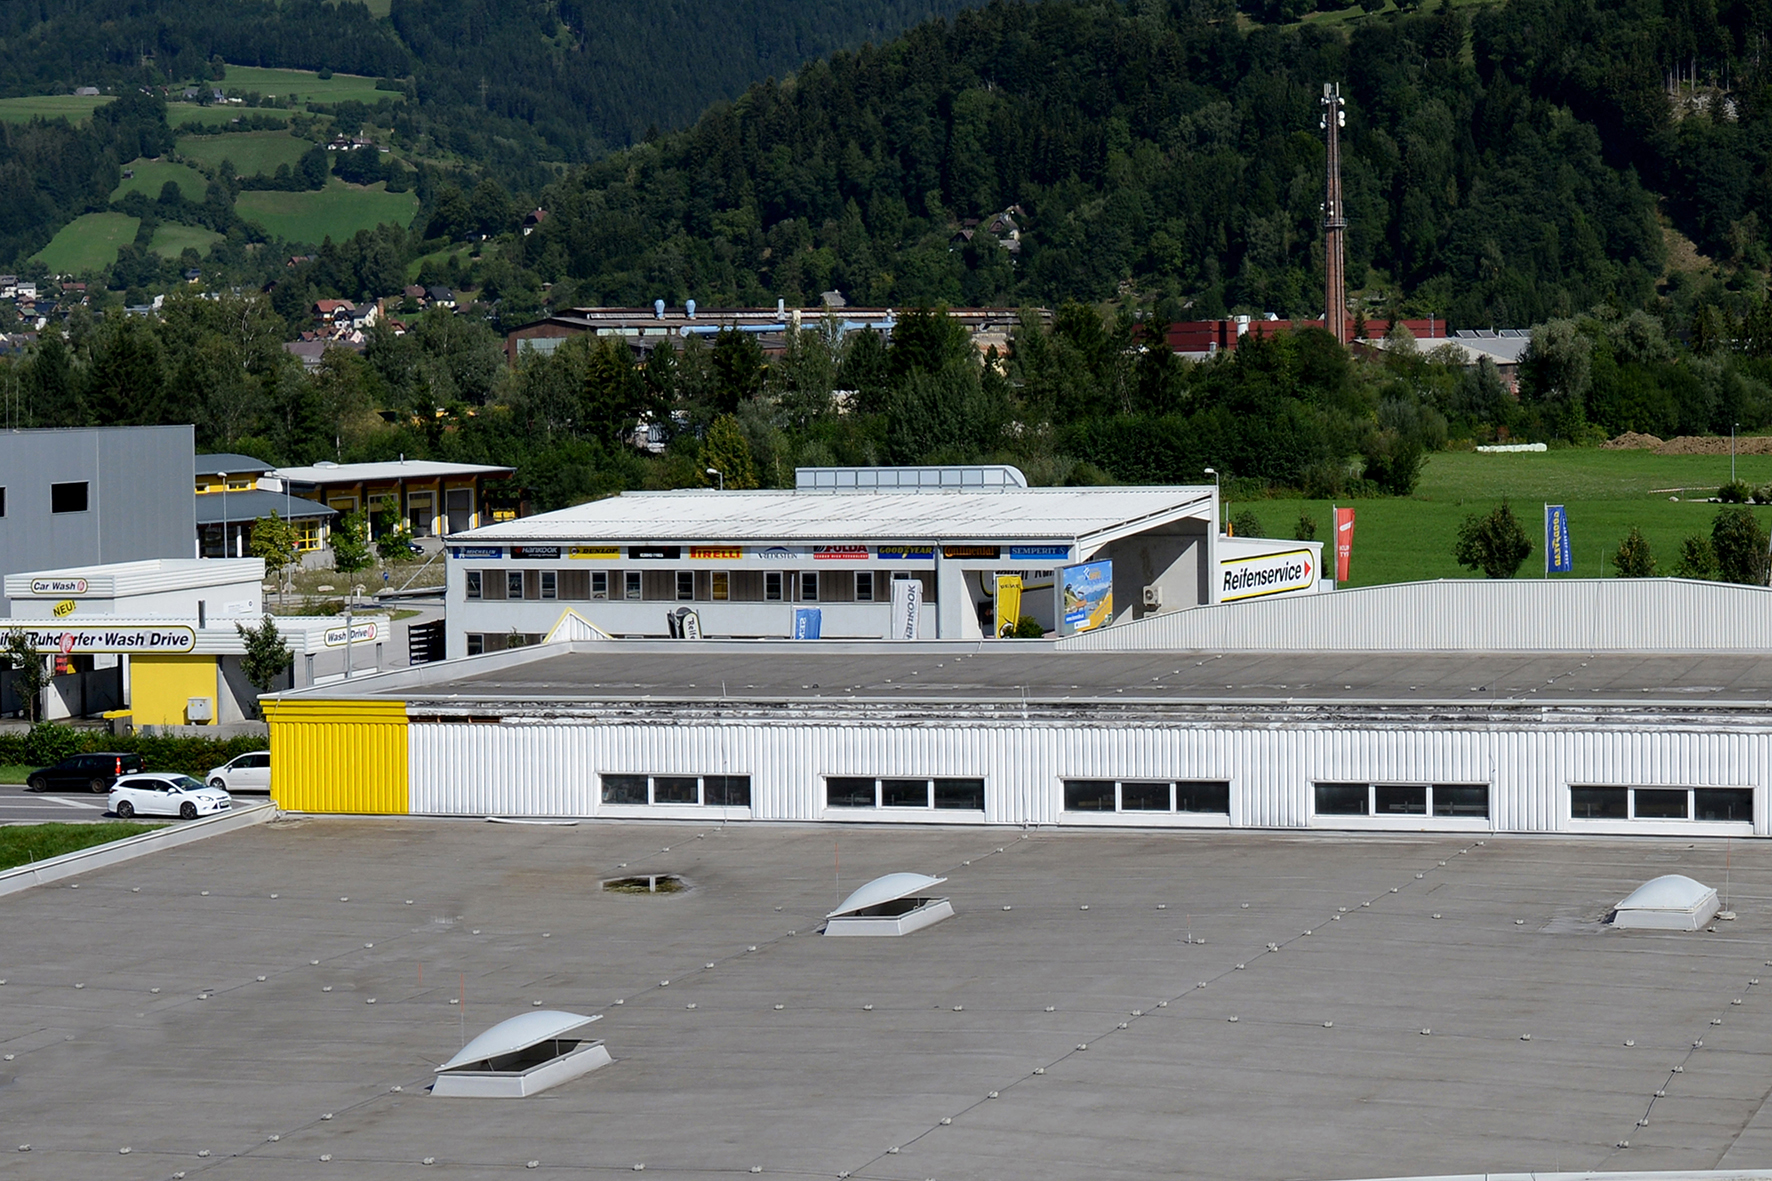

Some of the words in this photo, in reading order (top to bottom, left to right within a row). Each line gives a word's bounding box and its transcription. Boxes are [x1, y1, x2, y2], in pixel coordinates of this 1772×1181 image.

[690, 545, 742, 559] PIRELLI
[825, 544, 868, 552] FULDA
[879, 545, 932, 555] GOODYEAR
[943, 545, 994, 556] Continental
[1223, 561, 1302, 592] Reifenservice
[33, 582, 49, 591] Car
[52, 581, 76, 591] Wash
[52, 600, 77, 617] NEU!
[328, 633, 346, 642] Wash
[350, 628, 368, 638] Drive
[27, 632, 96, 654] Ruhdrfer
[105, 632, 144, 646] Wash
[150, 632, 189, 646] Drive
